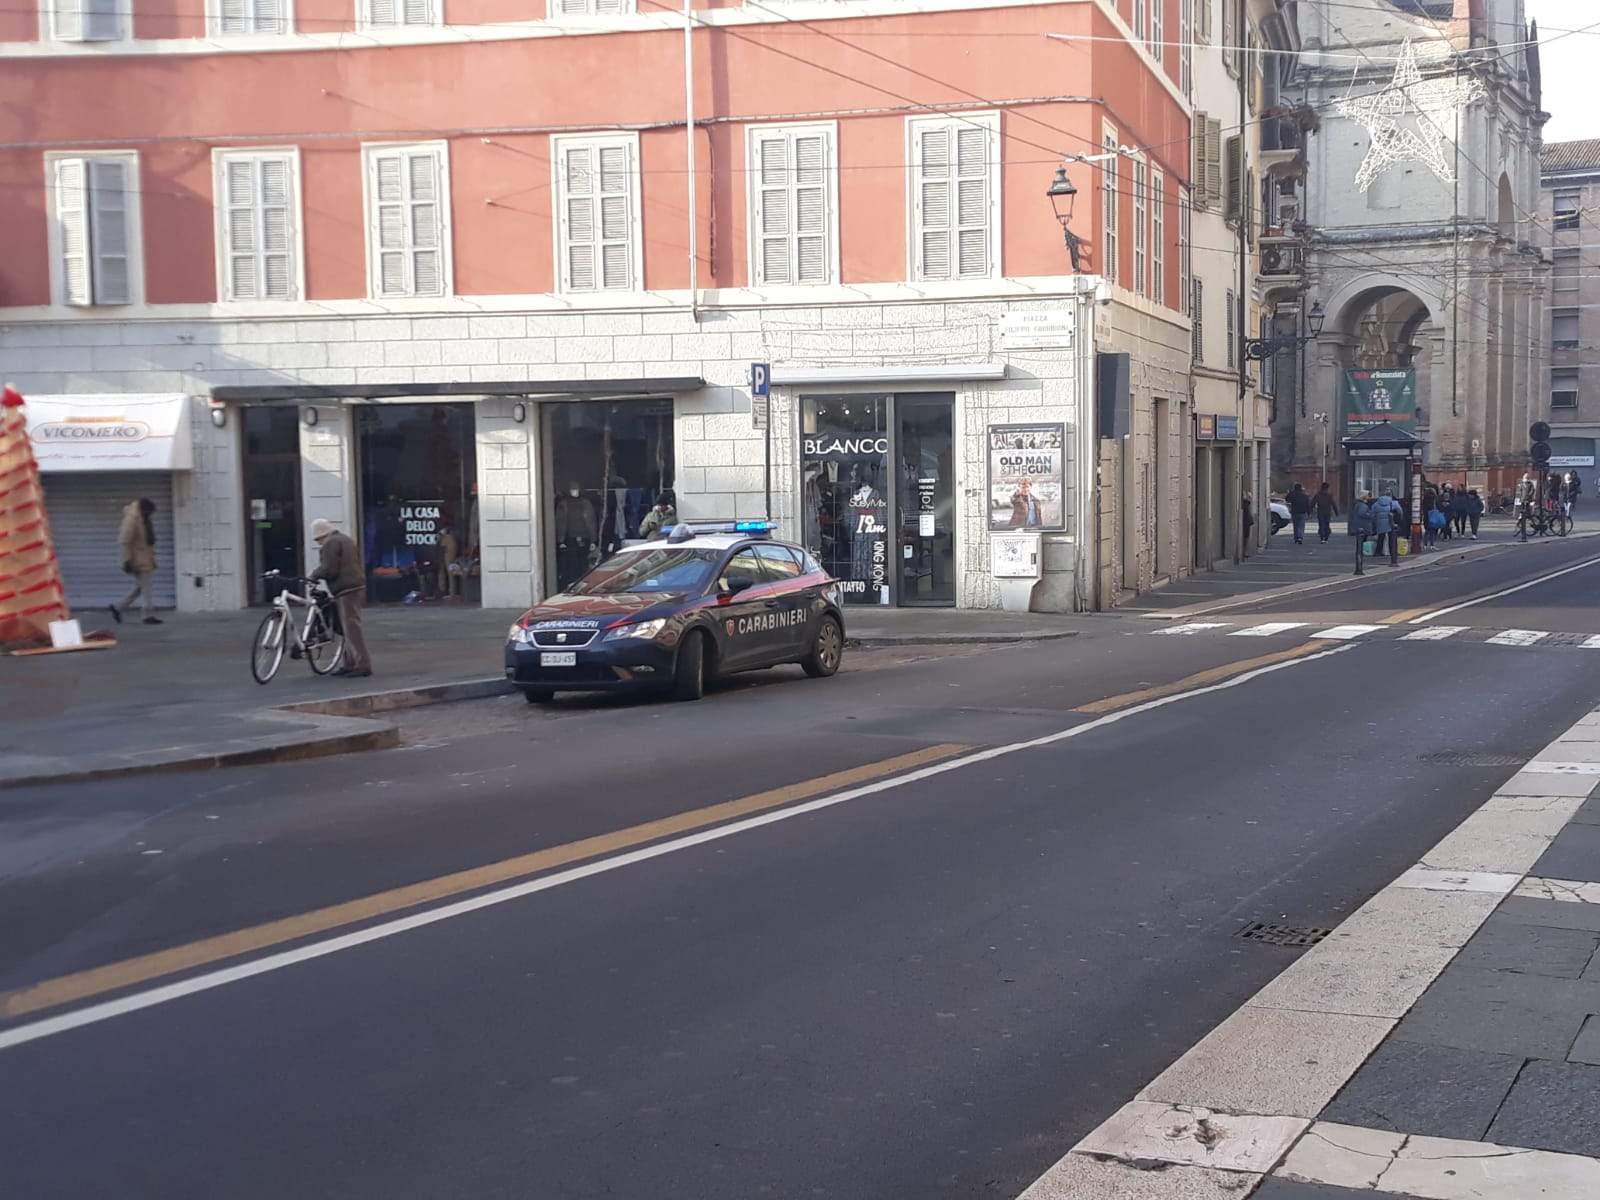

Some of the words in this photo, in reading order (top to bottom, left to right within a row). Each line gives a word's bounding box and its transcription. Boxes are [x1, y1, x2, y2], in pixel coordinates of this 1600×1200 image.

[755, 366, 765, 393] P
[43, 426, 140, 438] VICOMERO
[1000, 456, 1023, 465] OLD
[1026, 456, 1052, 465] MAN
[1028, 465, 1052, 474] GUN
[401, 507, 413, 518] LA
[415, 507, 440, 518] CASA
[406, 520, 435, 531] DELLO
[406, 533, 439, 544] STOCK
[873, 541, 885, 562] KING
[872, 564, 885, 591] KONG
[536, 620, 600, 628] CARABINIERI
[738, 608, 807, 634] CARABINIERI
